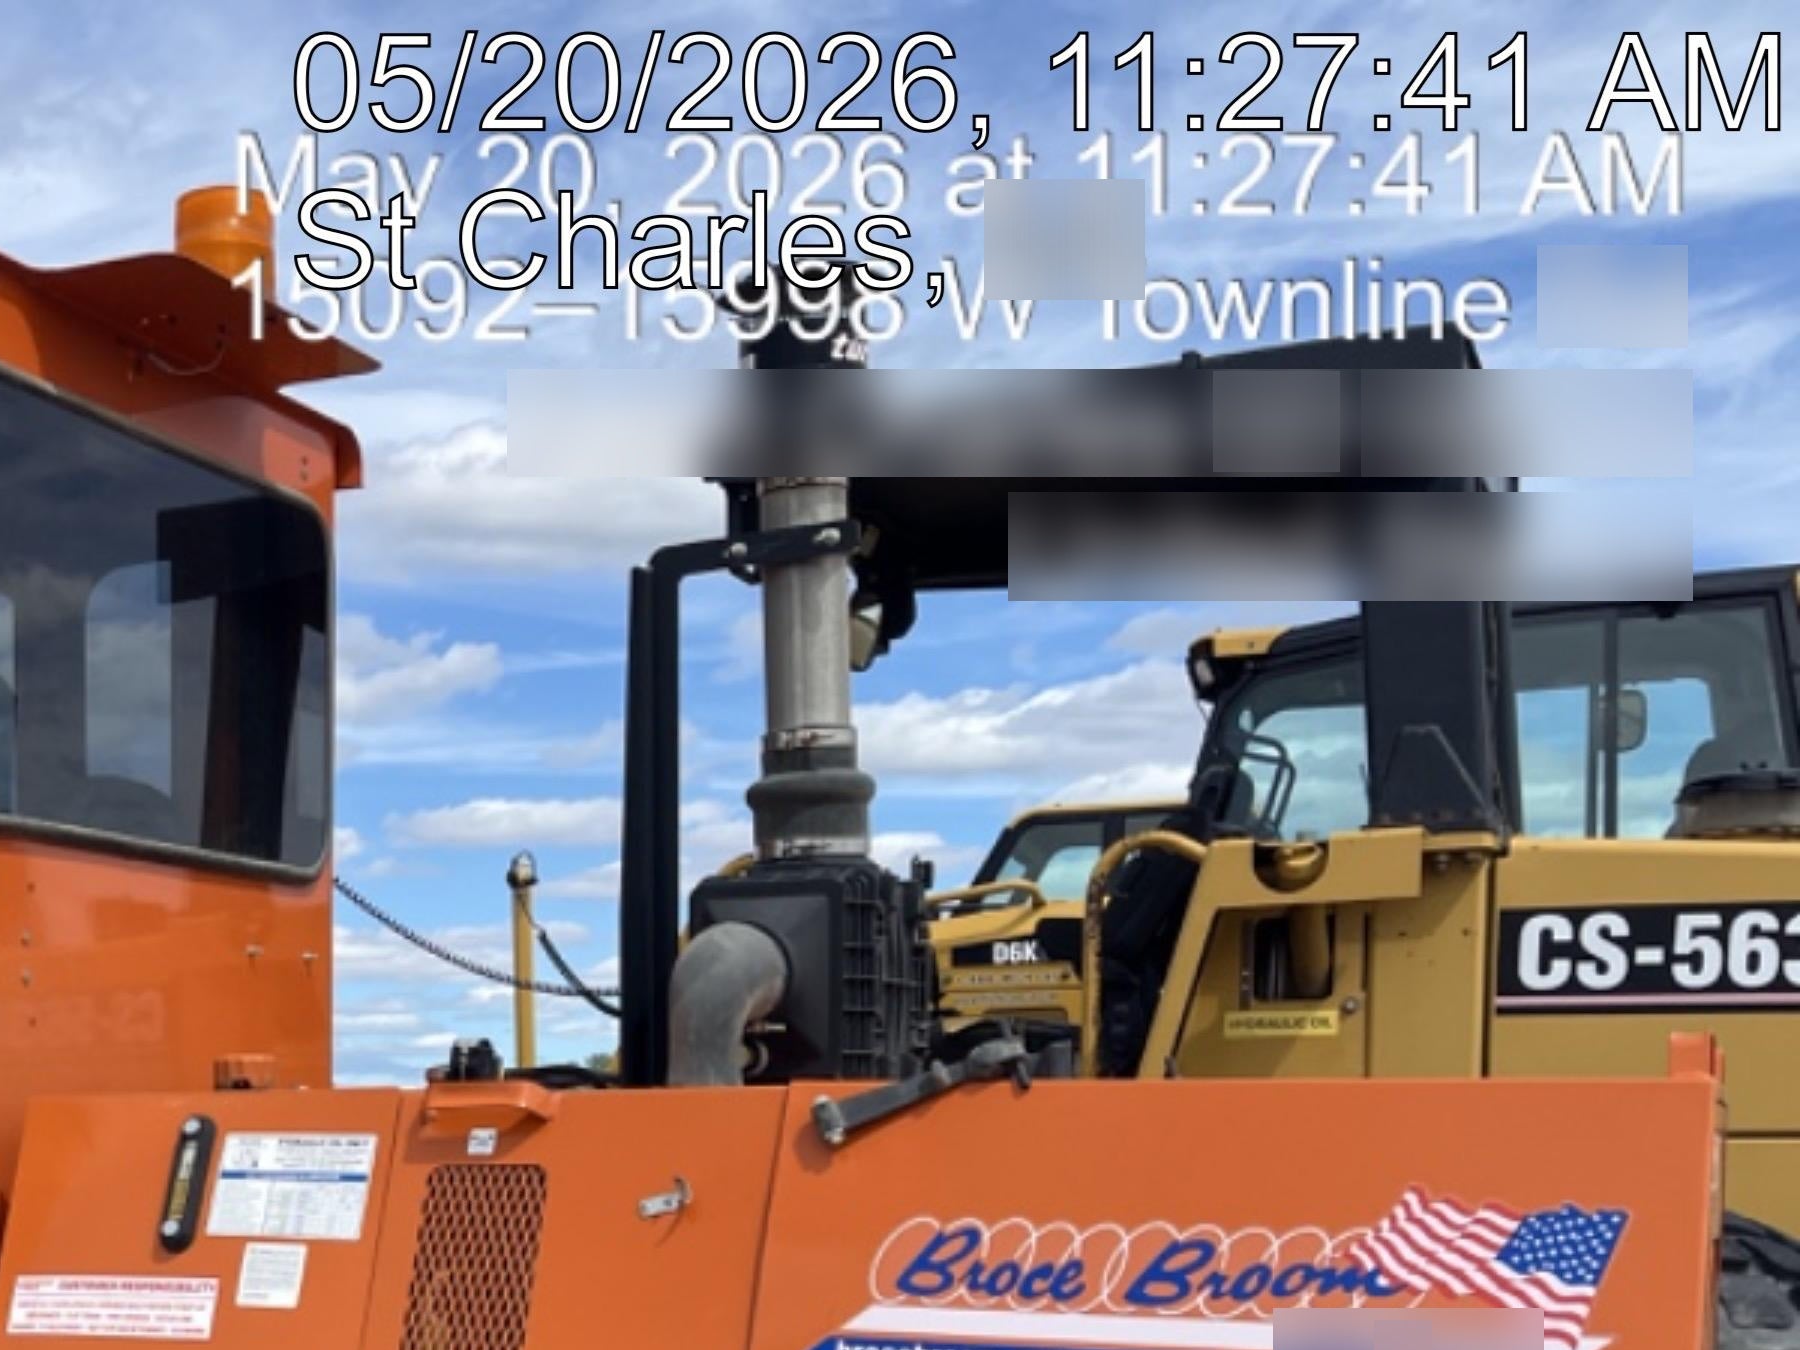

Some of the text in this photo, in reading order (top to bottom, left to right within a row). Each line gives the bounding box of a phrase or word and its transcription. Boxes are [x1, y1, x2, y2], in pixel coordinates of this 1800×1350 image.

[991, 940, 1038, 965] D6K
[895, 1225, 1410, 1303] Broce Broom
